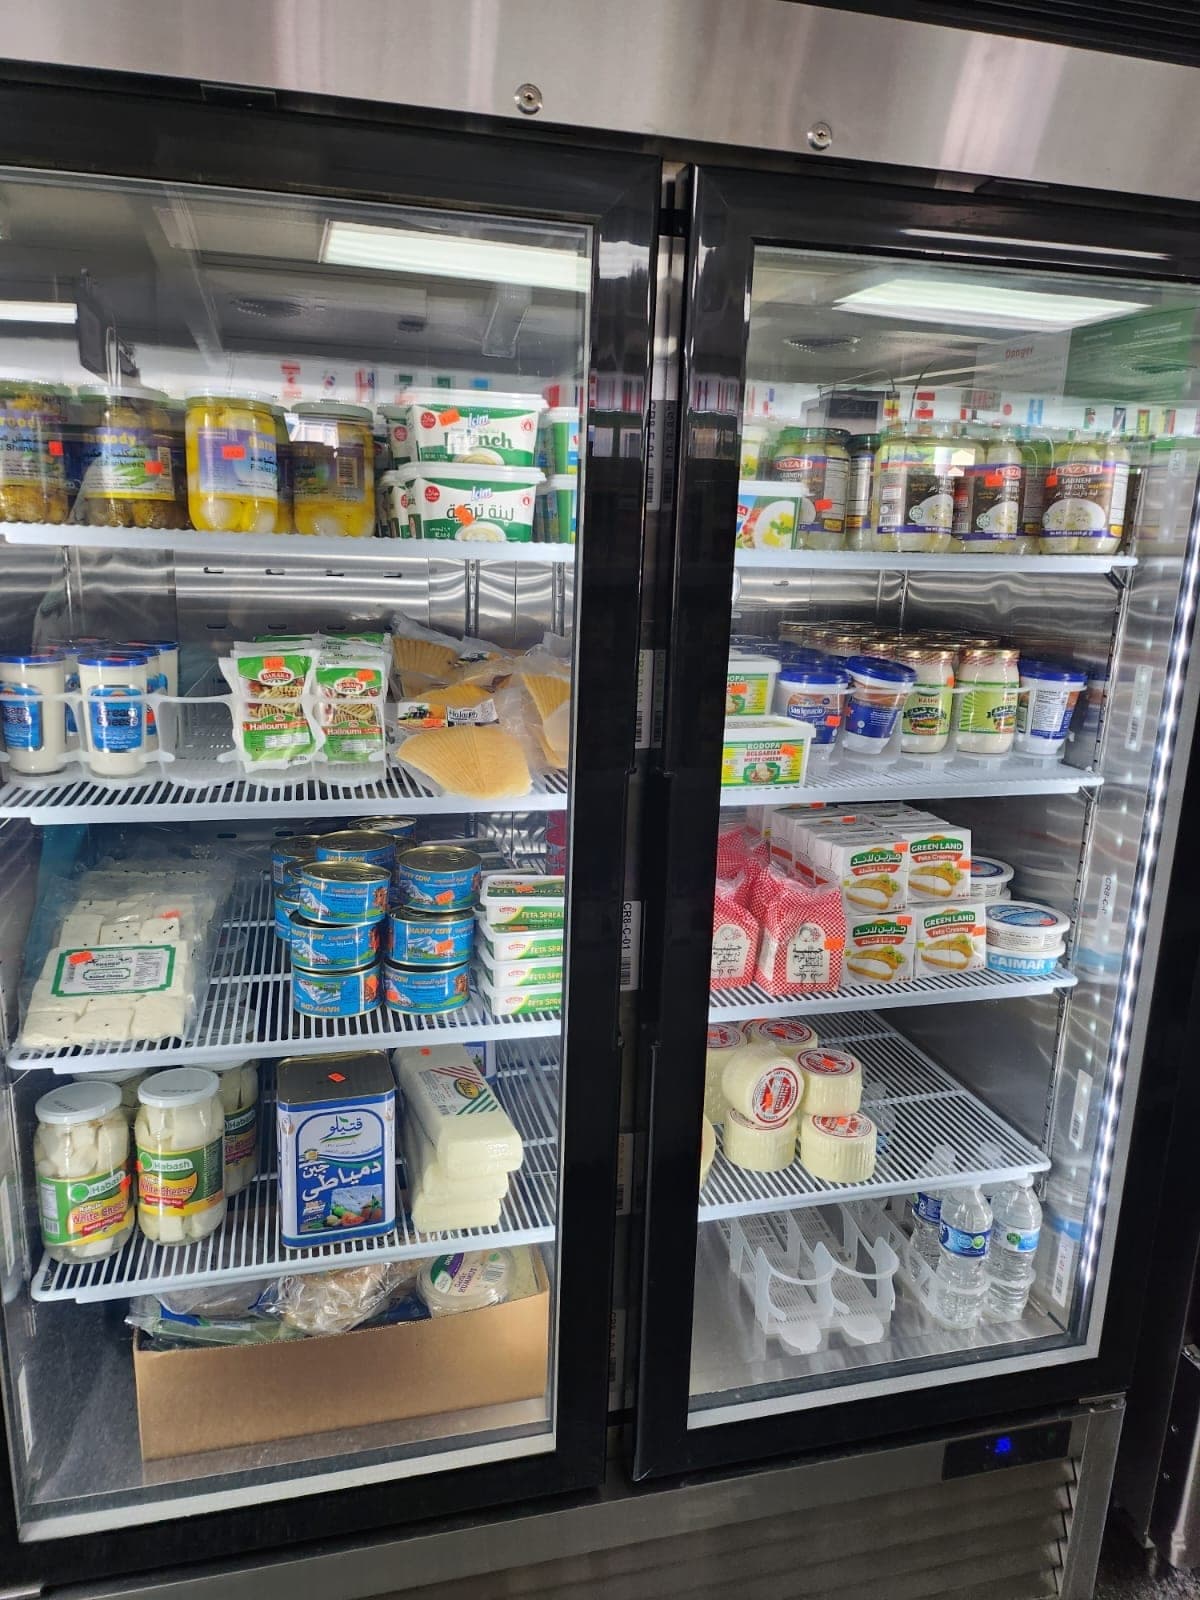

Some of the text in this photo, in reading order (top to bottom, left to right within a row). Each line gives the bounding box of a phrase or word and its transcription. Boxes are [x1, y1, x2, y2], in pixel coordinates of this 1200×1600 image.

[911, 842, 962, 852] GREEN LAND
[622, 902, 633, 951] CR8-C-01
[924, 913, 975, 928] GREEN LAND
[154, 1160, 190, 1170] Habash
[72, 1211, 99, 1225] White
